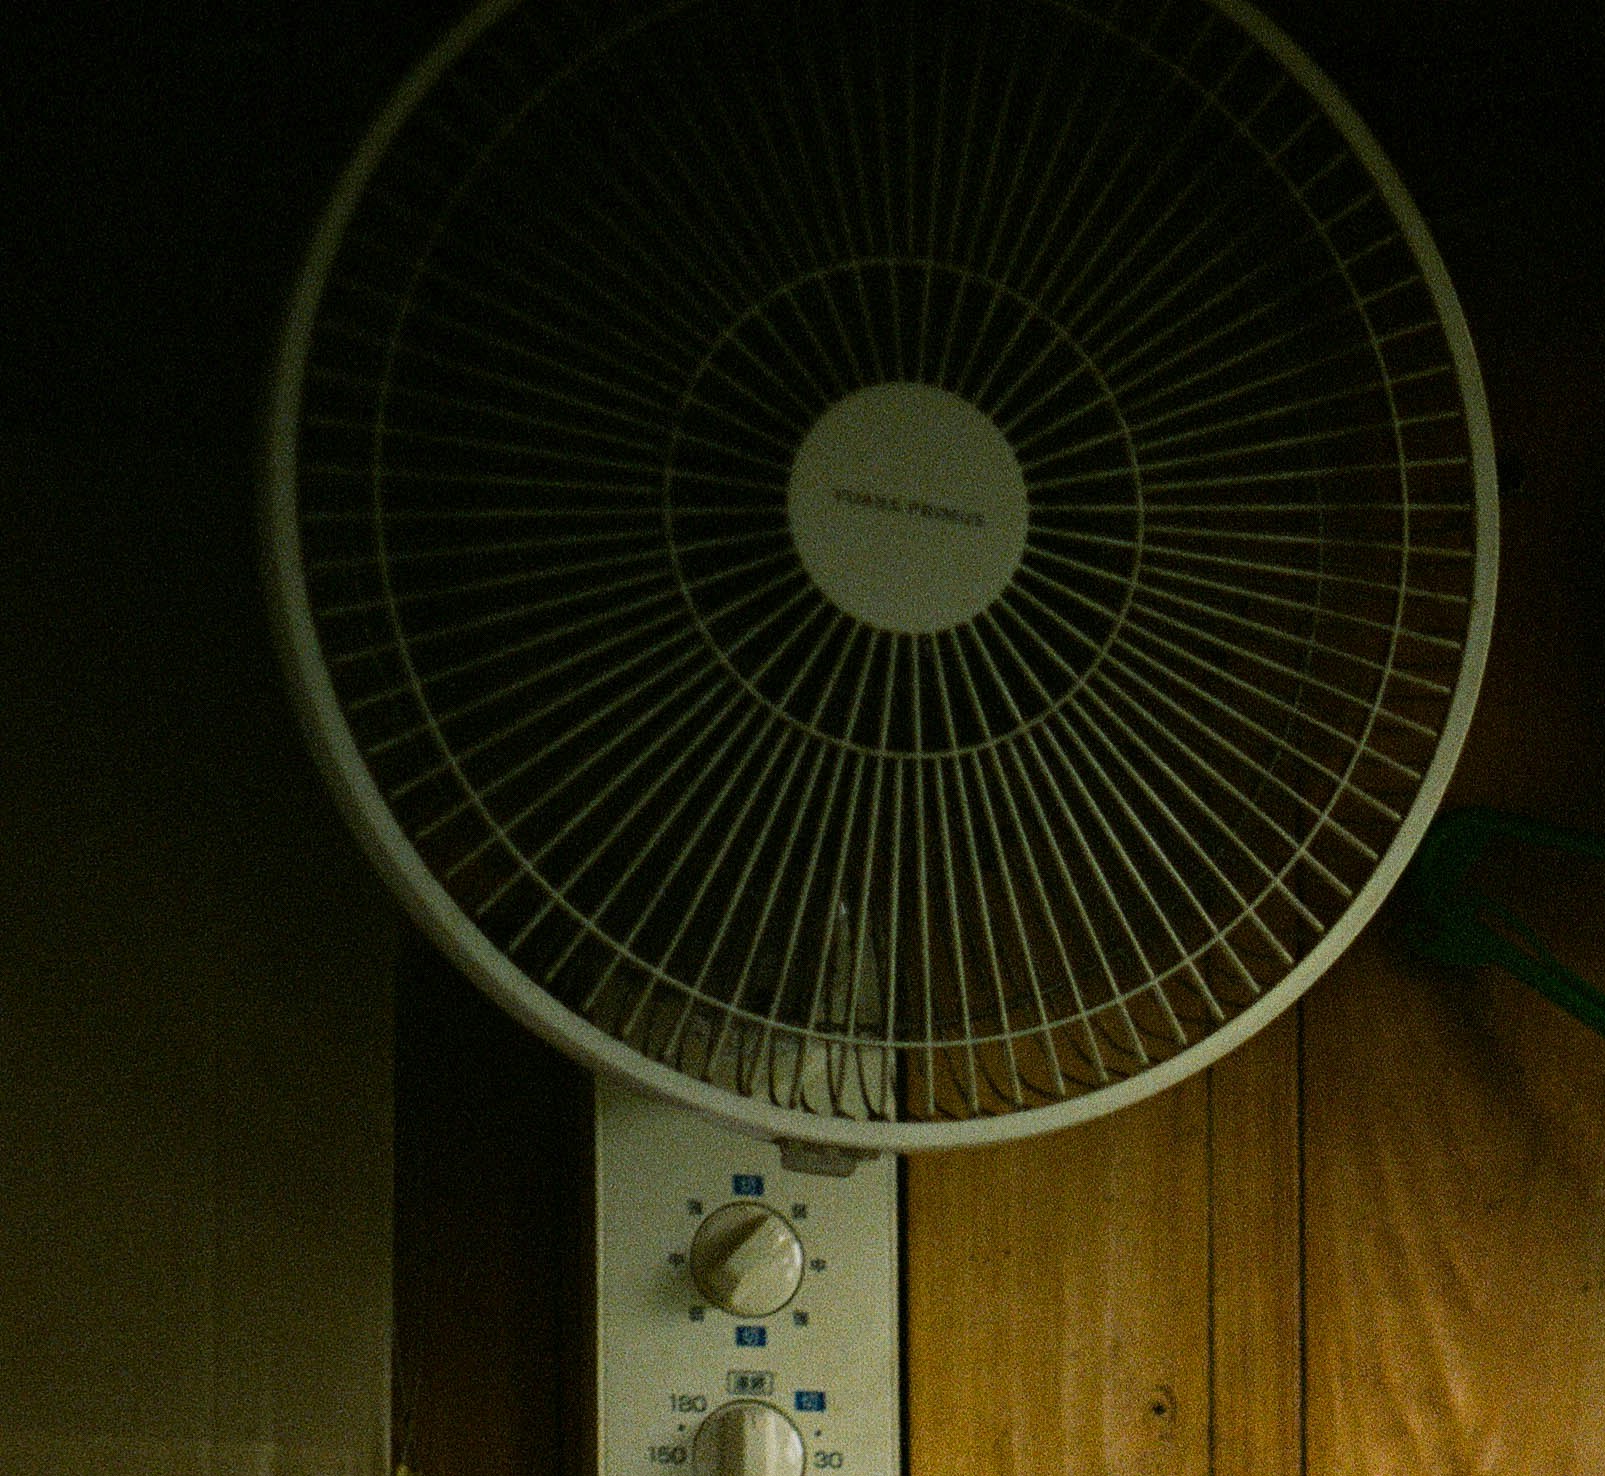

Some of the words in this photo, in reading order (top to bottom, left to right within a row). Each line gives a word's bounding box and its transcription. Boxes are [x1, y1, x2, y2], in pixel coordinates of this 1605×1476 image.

[670, 1394, 707, 1413] 180
[649, 1446, 687, 1464] 150
[814, 1451, 844, 1469] 30
